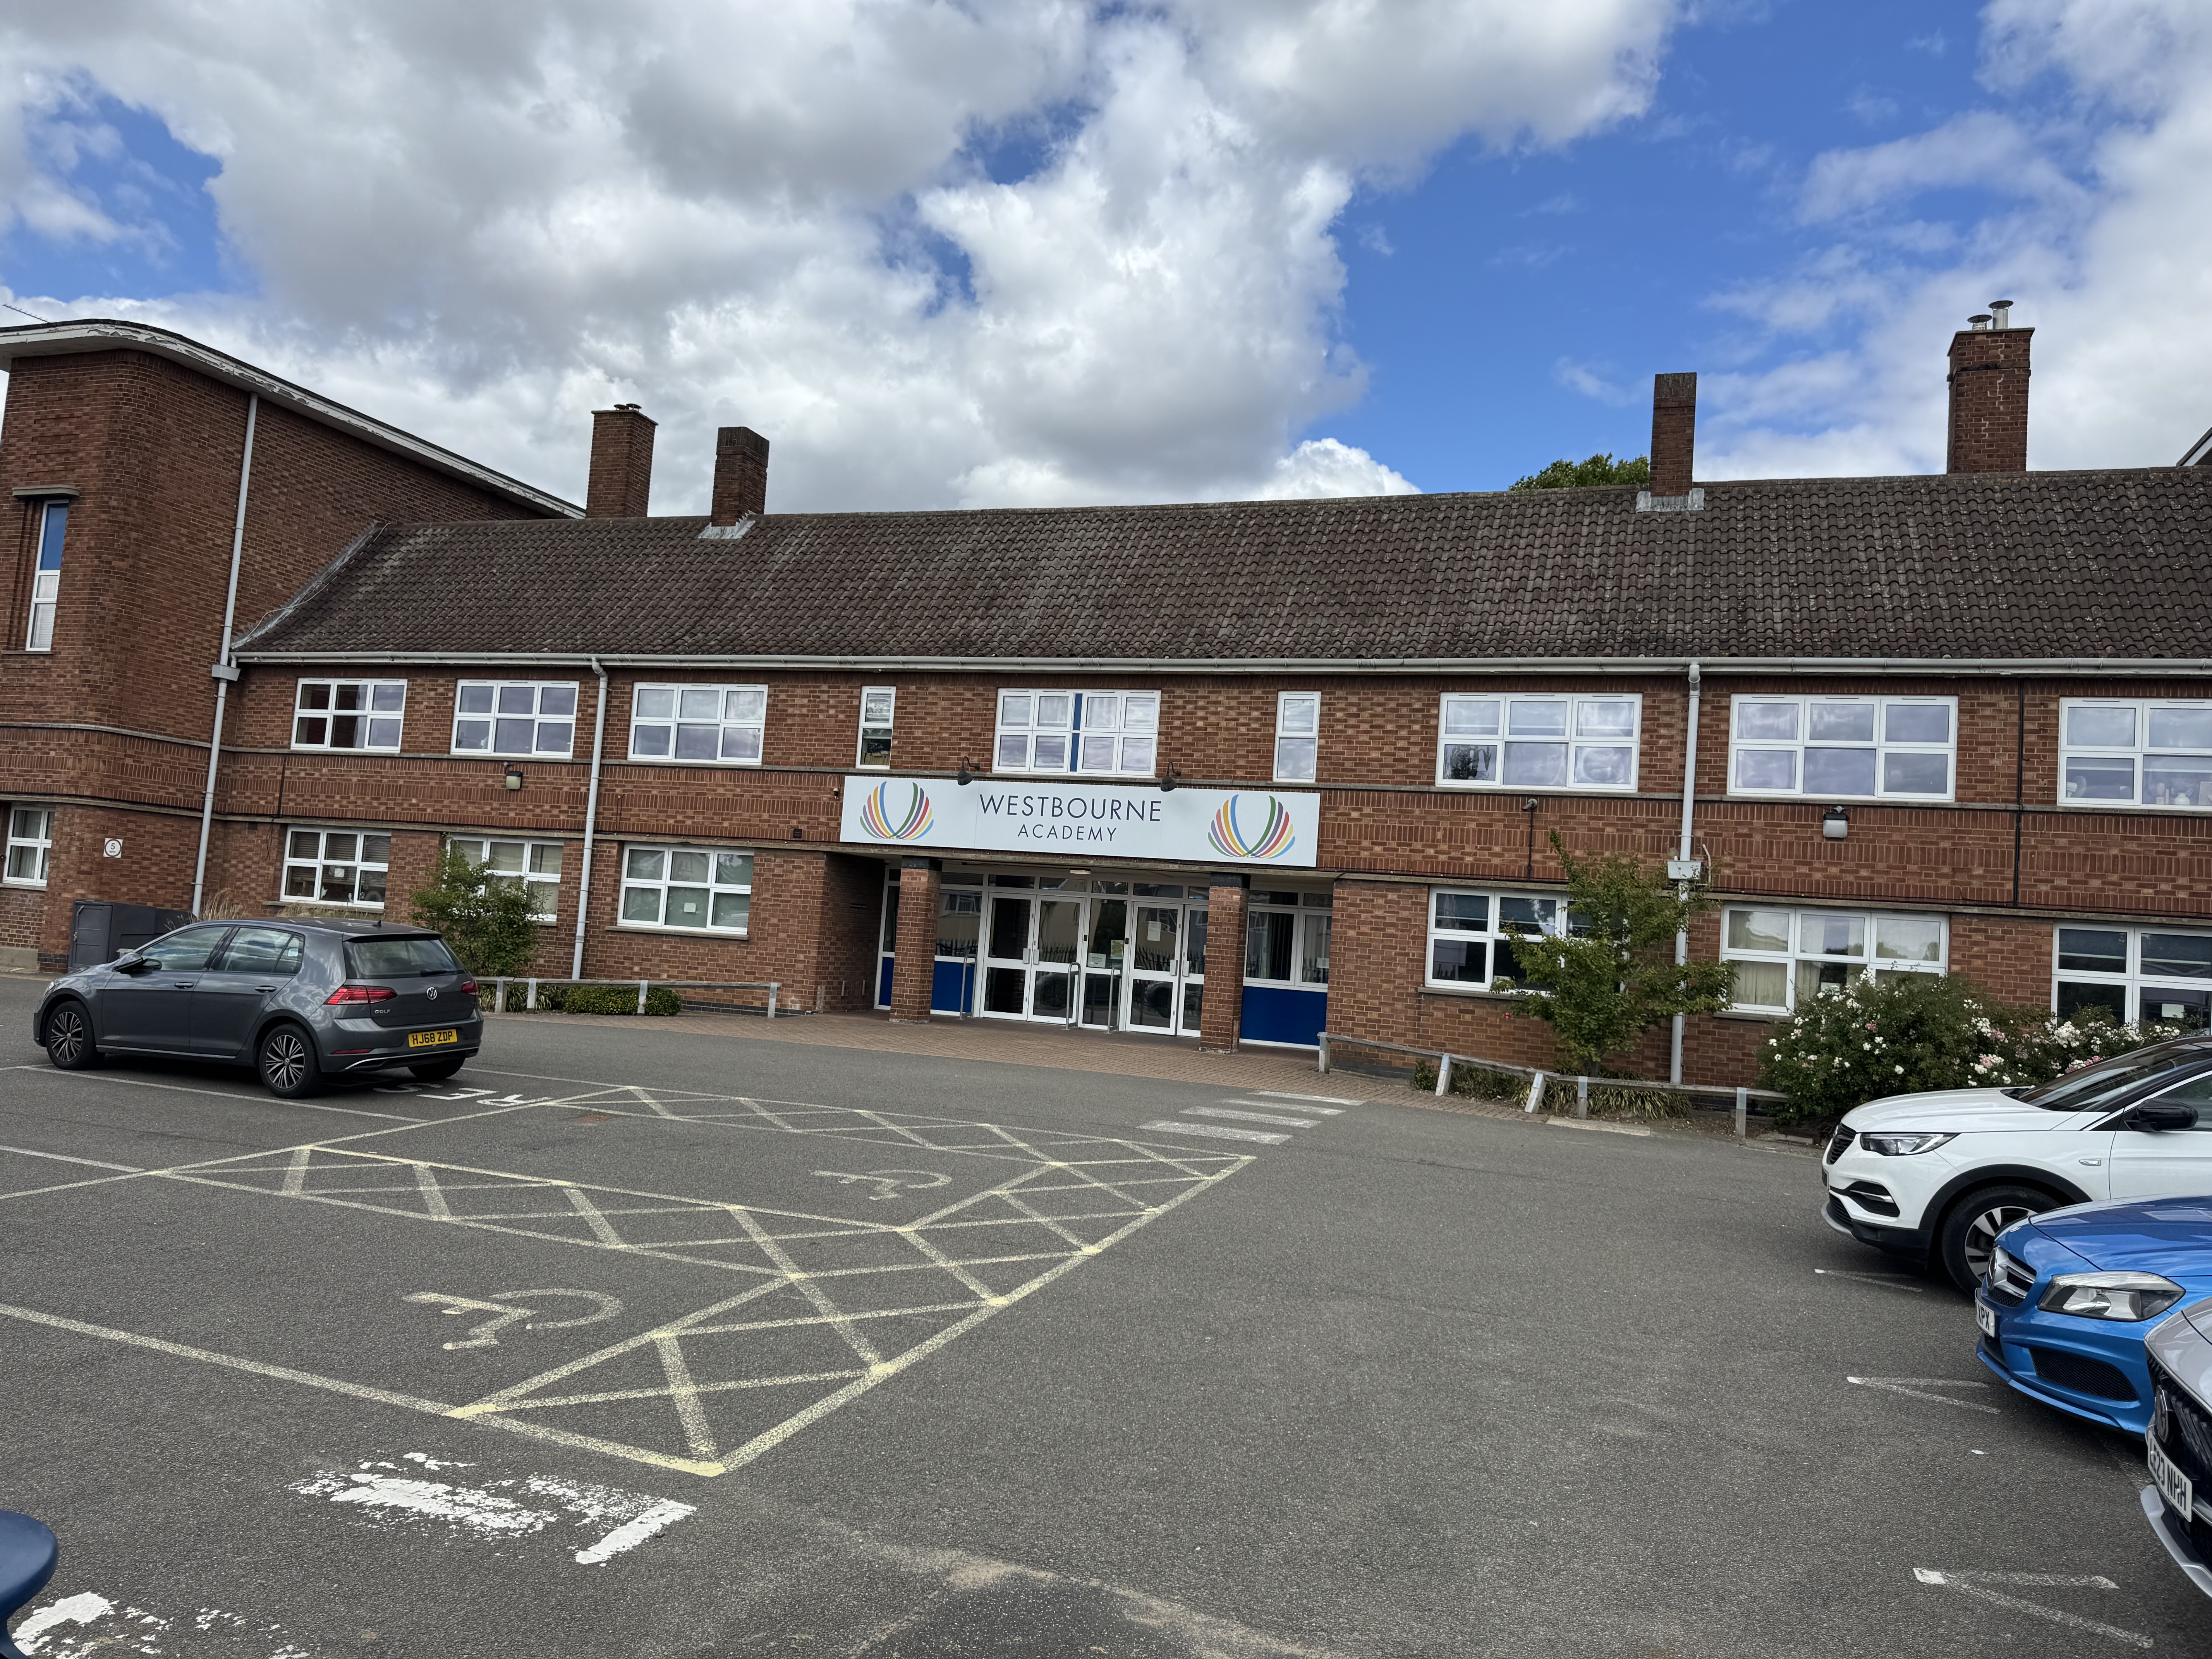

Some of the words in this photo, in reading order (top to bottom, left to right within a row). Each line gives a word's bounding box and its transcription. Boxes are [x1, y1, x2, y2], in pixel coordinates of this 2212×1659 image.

[979, 794, 1161, 821] WESTBOURNE
[1017, 823, 1116, 842] ACADEMY
[412, 1033, 435, 1045] HJ68
[437, 1031, 453, 1042] ZDP
[1977, 1303, 1990, 1330] XPX
[2150, 1438, 2165, 1486] LE23
[2167, 1464, 2186, 1511] NHH
